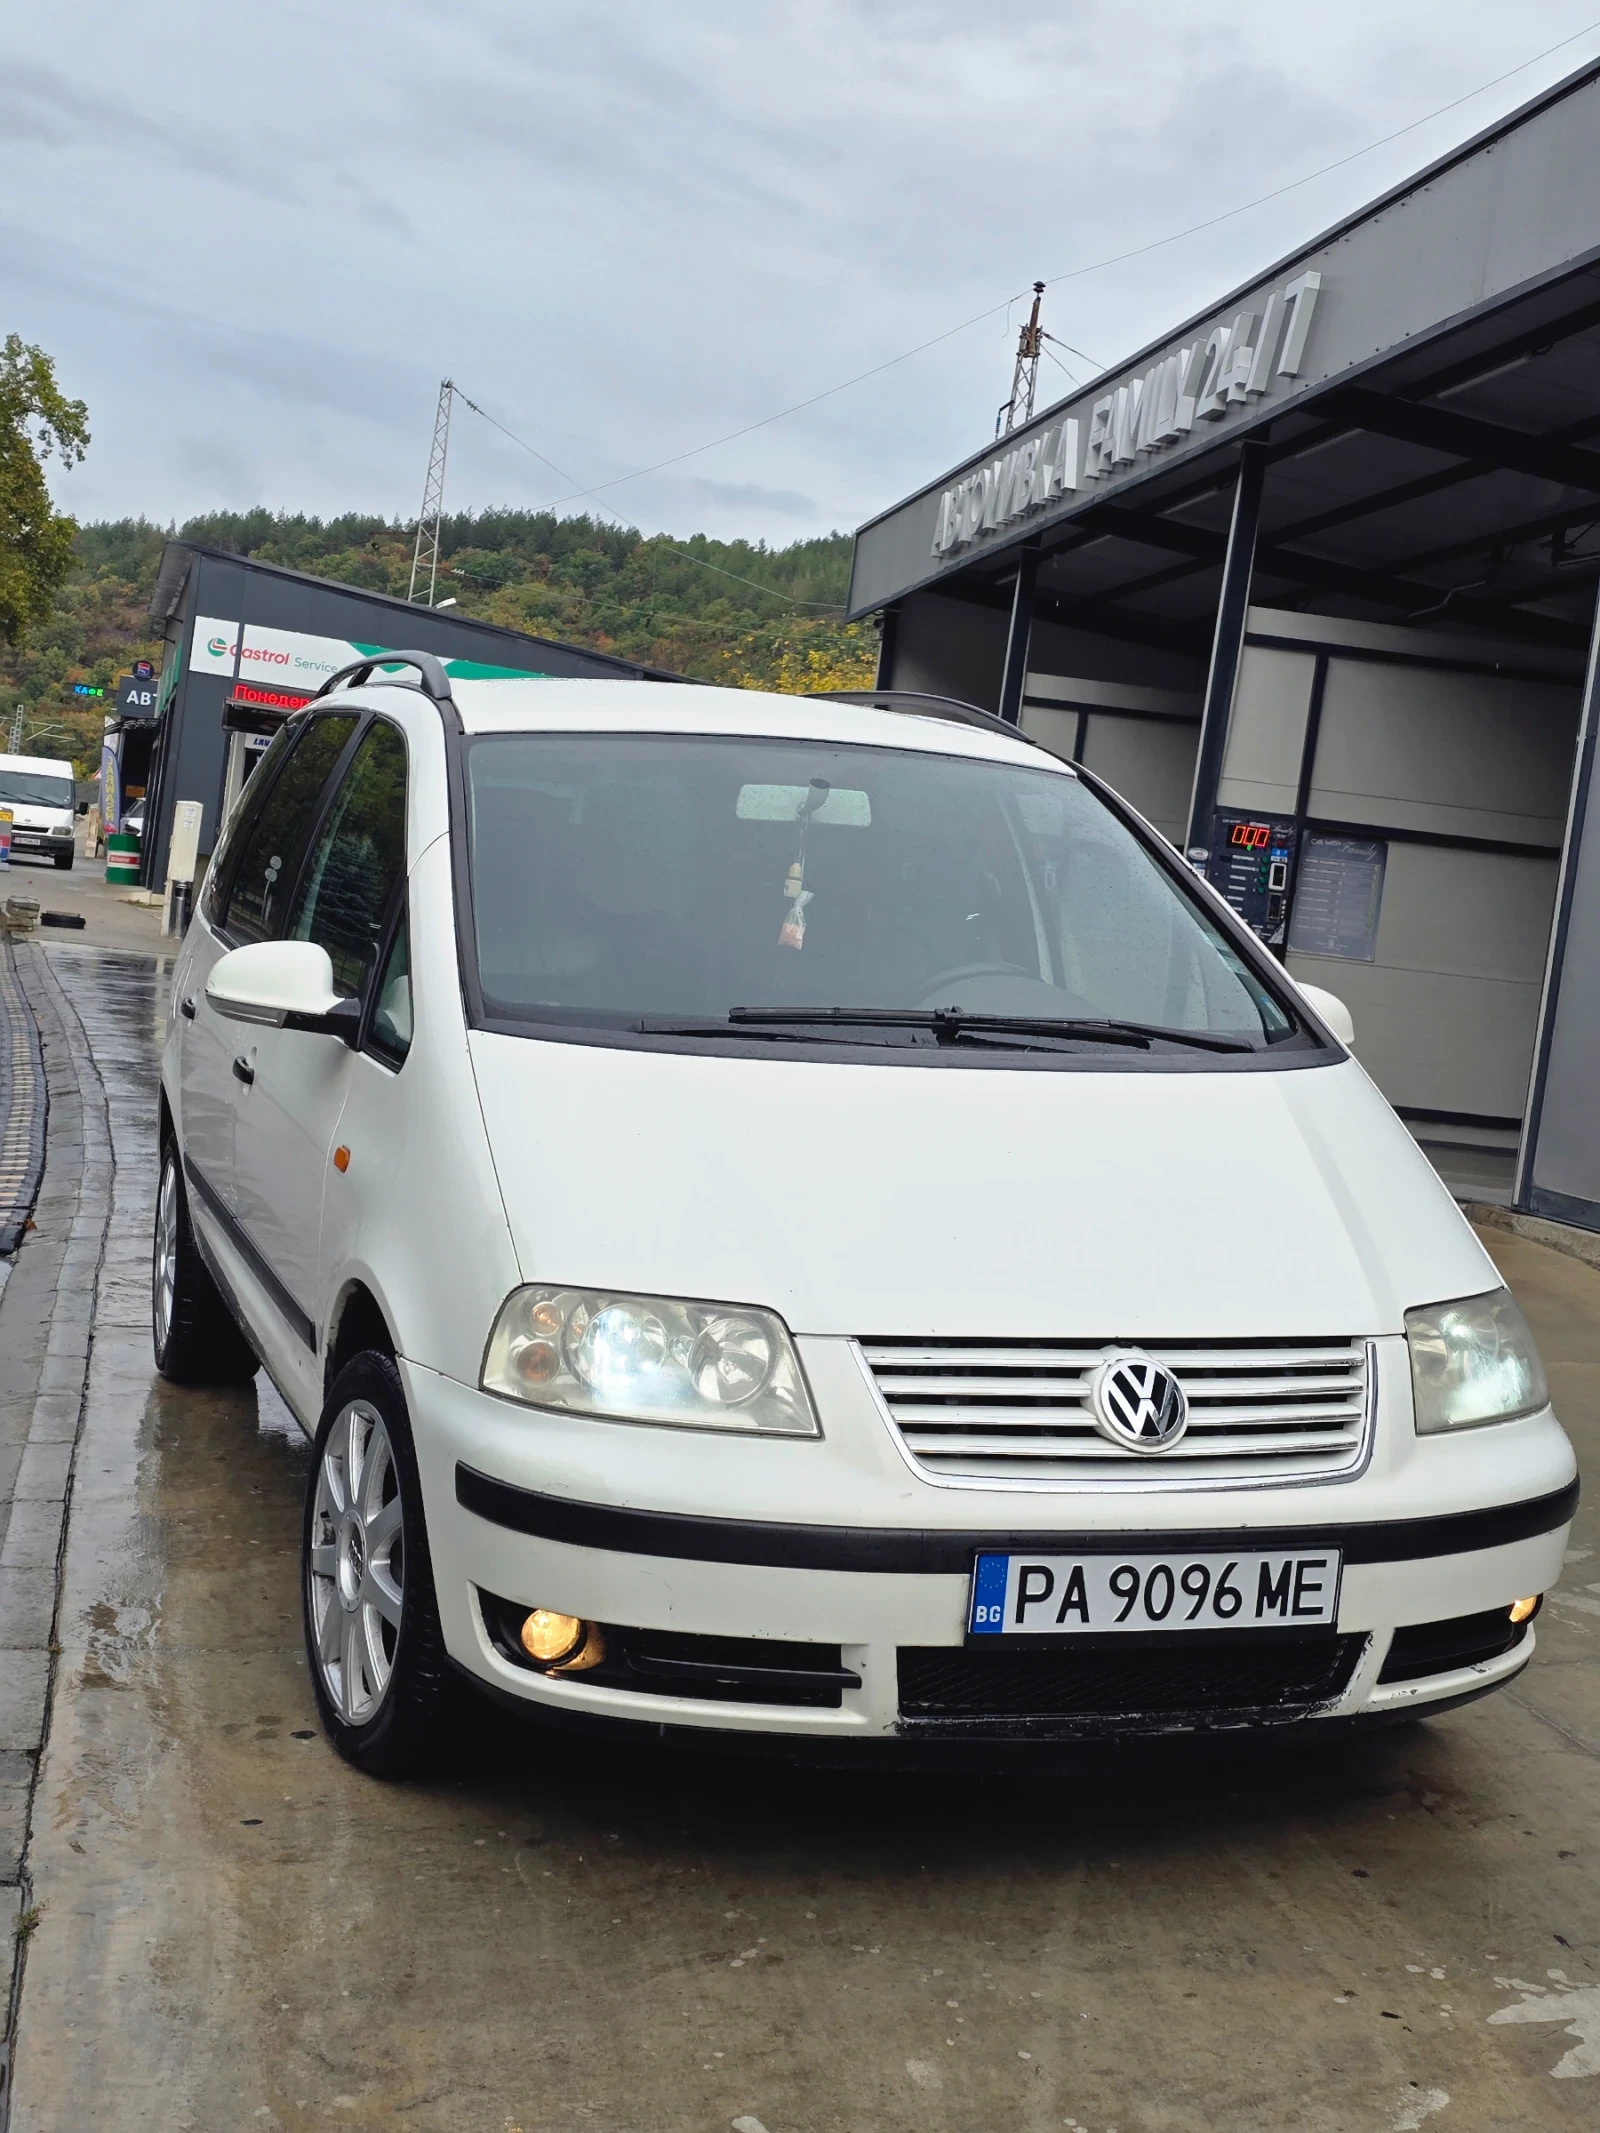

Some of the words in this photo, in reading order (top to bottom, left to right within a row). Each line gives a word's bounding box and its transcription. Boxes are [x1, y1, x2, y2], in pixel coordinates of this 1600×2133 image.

[1083, 338, 1207, 480] FAMILY
[1196, 271, 1321, 421] 24/7
[229, 643, 290, 666] Castrol
[293, 657, 338, 674] Service
[1231, 825, 1269, 847] 000
[975, 1605, 1001, 1624] BG
[1015, 1563, 1091, 1624] PA
[1108, 1561, 1243, 1623] 9096
[1254, 1559, 1328, 1618] ME
